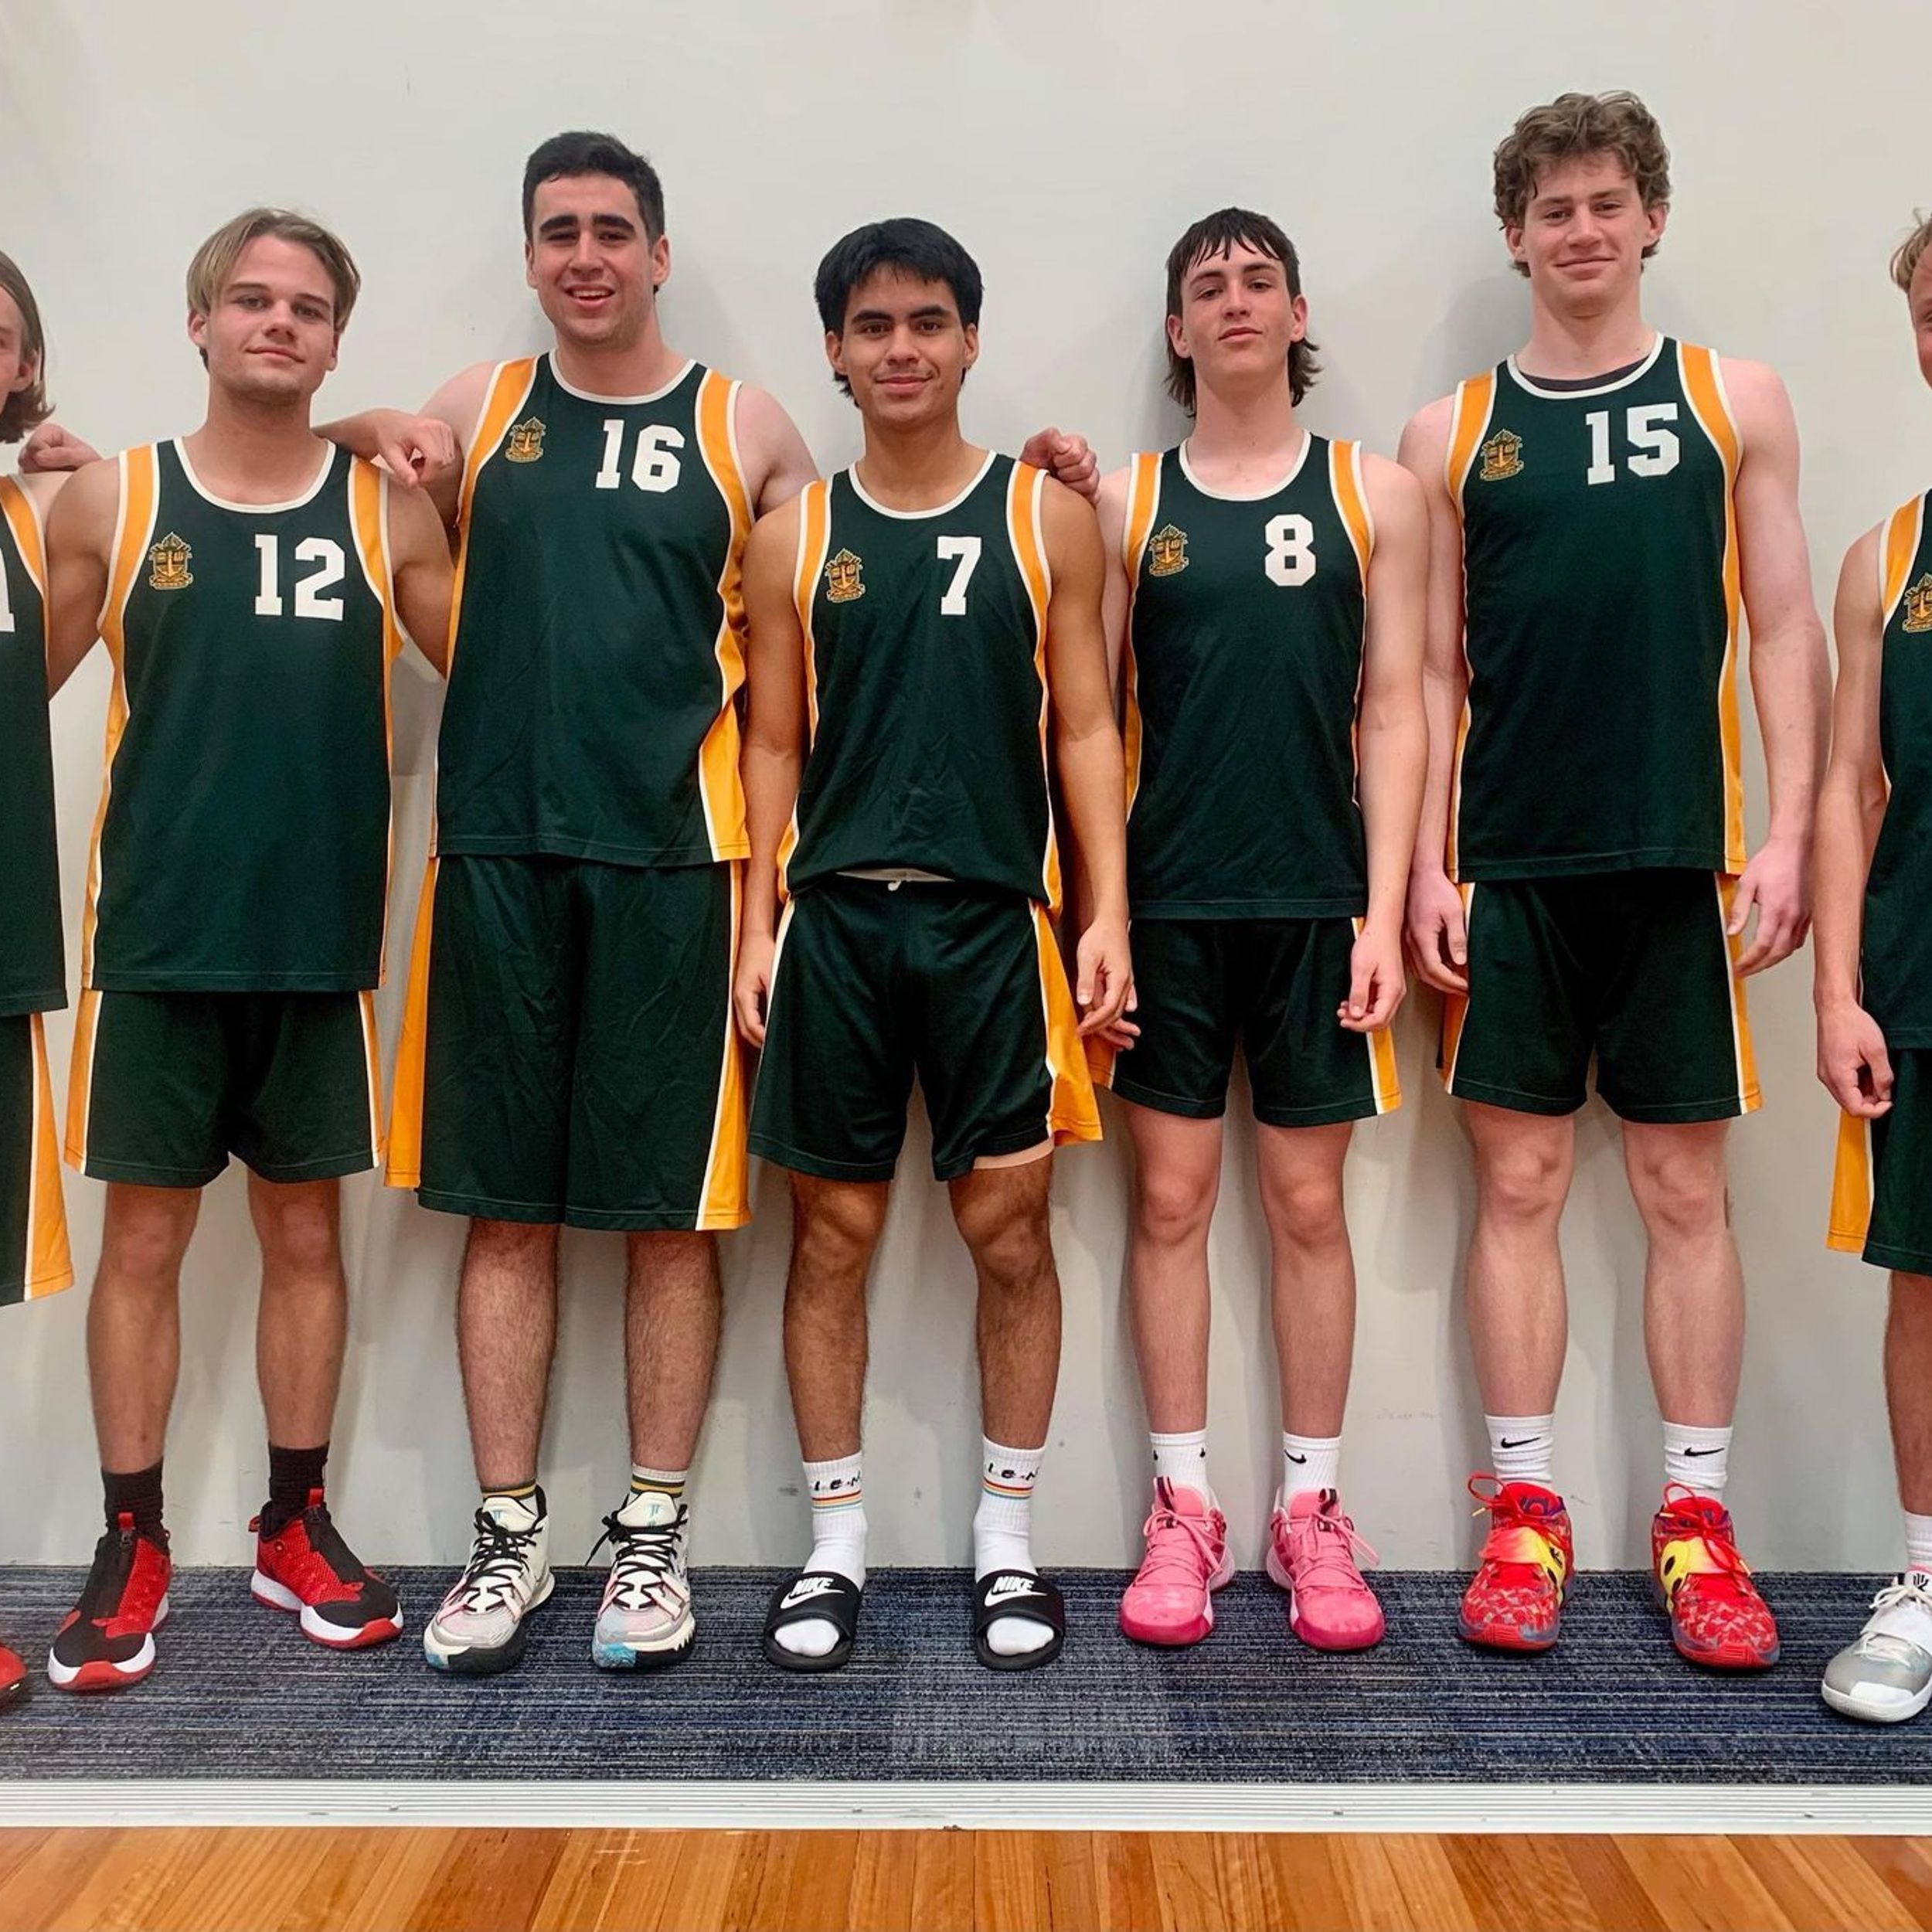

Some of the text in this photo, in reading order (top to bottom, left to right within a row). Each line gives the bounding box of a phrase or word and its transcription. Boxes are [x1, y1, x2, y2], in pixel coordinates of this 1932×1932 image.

[595, 419, 685, 493] 16
[1586, 402, 1680, 485] 15
[254, 533, 345, 621] 12
[937, 536, 981, 616] 7
[1264, 513, 1316, 587] 8
[790, 1577, 834, 1597] NIKE
[992, 1576, 1035, 1593] NIKE
